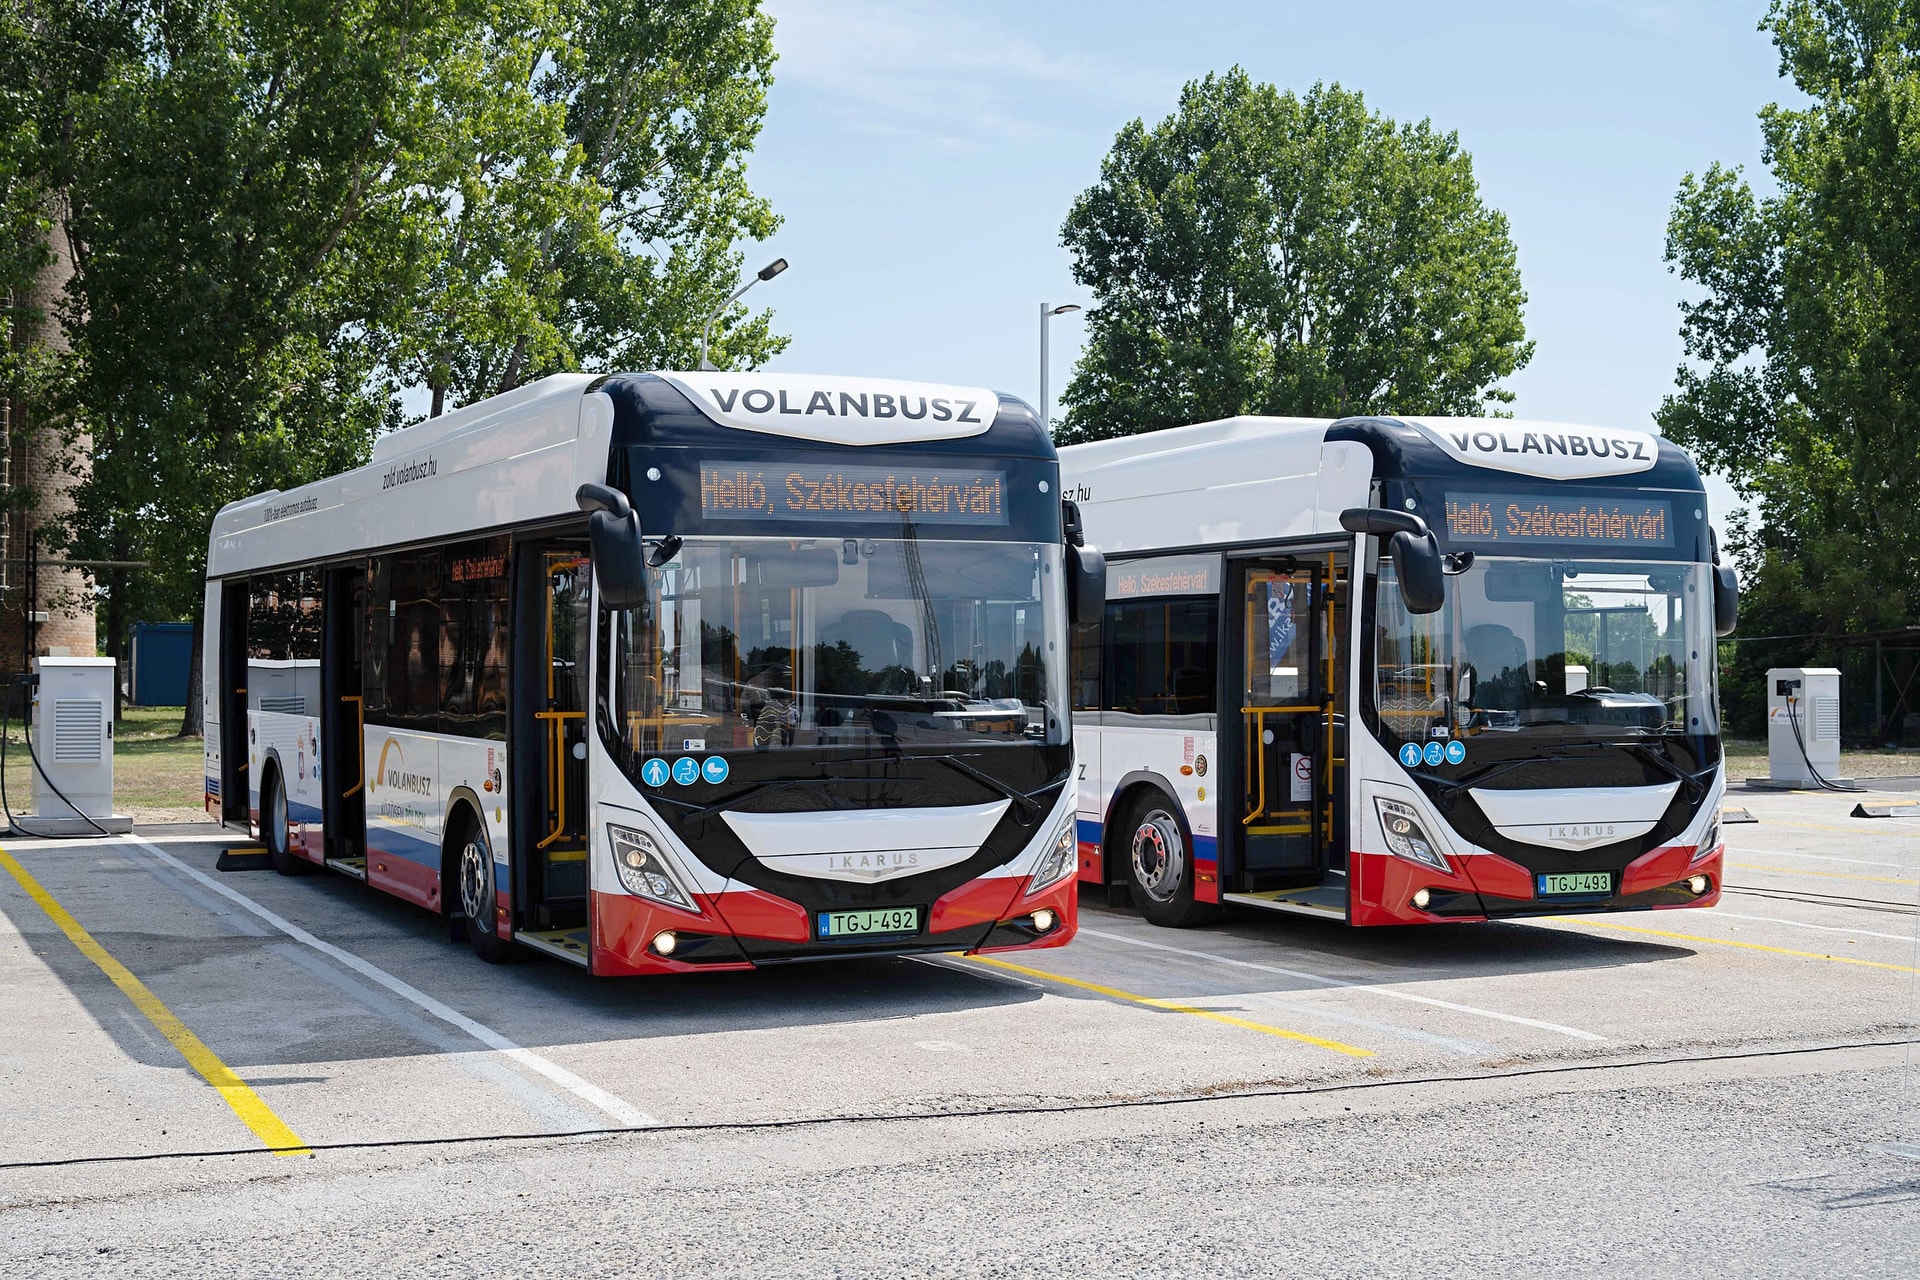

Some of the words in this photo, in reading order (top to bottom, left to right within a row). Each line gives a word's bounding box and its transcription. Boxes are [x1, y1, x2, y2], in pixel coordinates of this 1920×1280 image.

[710, 388, 982, 423] VOLÁNBUSZ
[1450, 432, 1651, 462] VOLÁNBUSZ
[700, 469, 774, 515] Helló,
[785, 471, 1001, 515] Székesfehérvár!
[1062, 483, 1091, 502] sz.hu
[1444, 501, 1498, 540] Helló,
[1506, 503, 1665, 540] Székesfehérvár!
[1549, 825, 1615, 838] IKARUS
[829, 853, 918, 869] IKARUS
[1549, 875, 1608, 892] TGJ-493
[833, 911, 913, 933] TGJ-492
